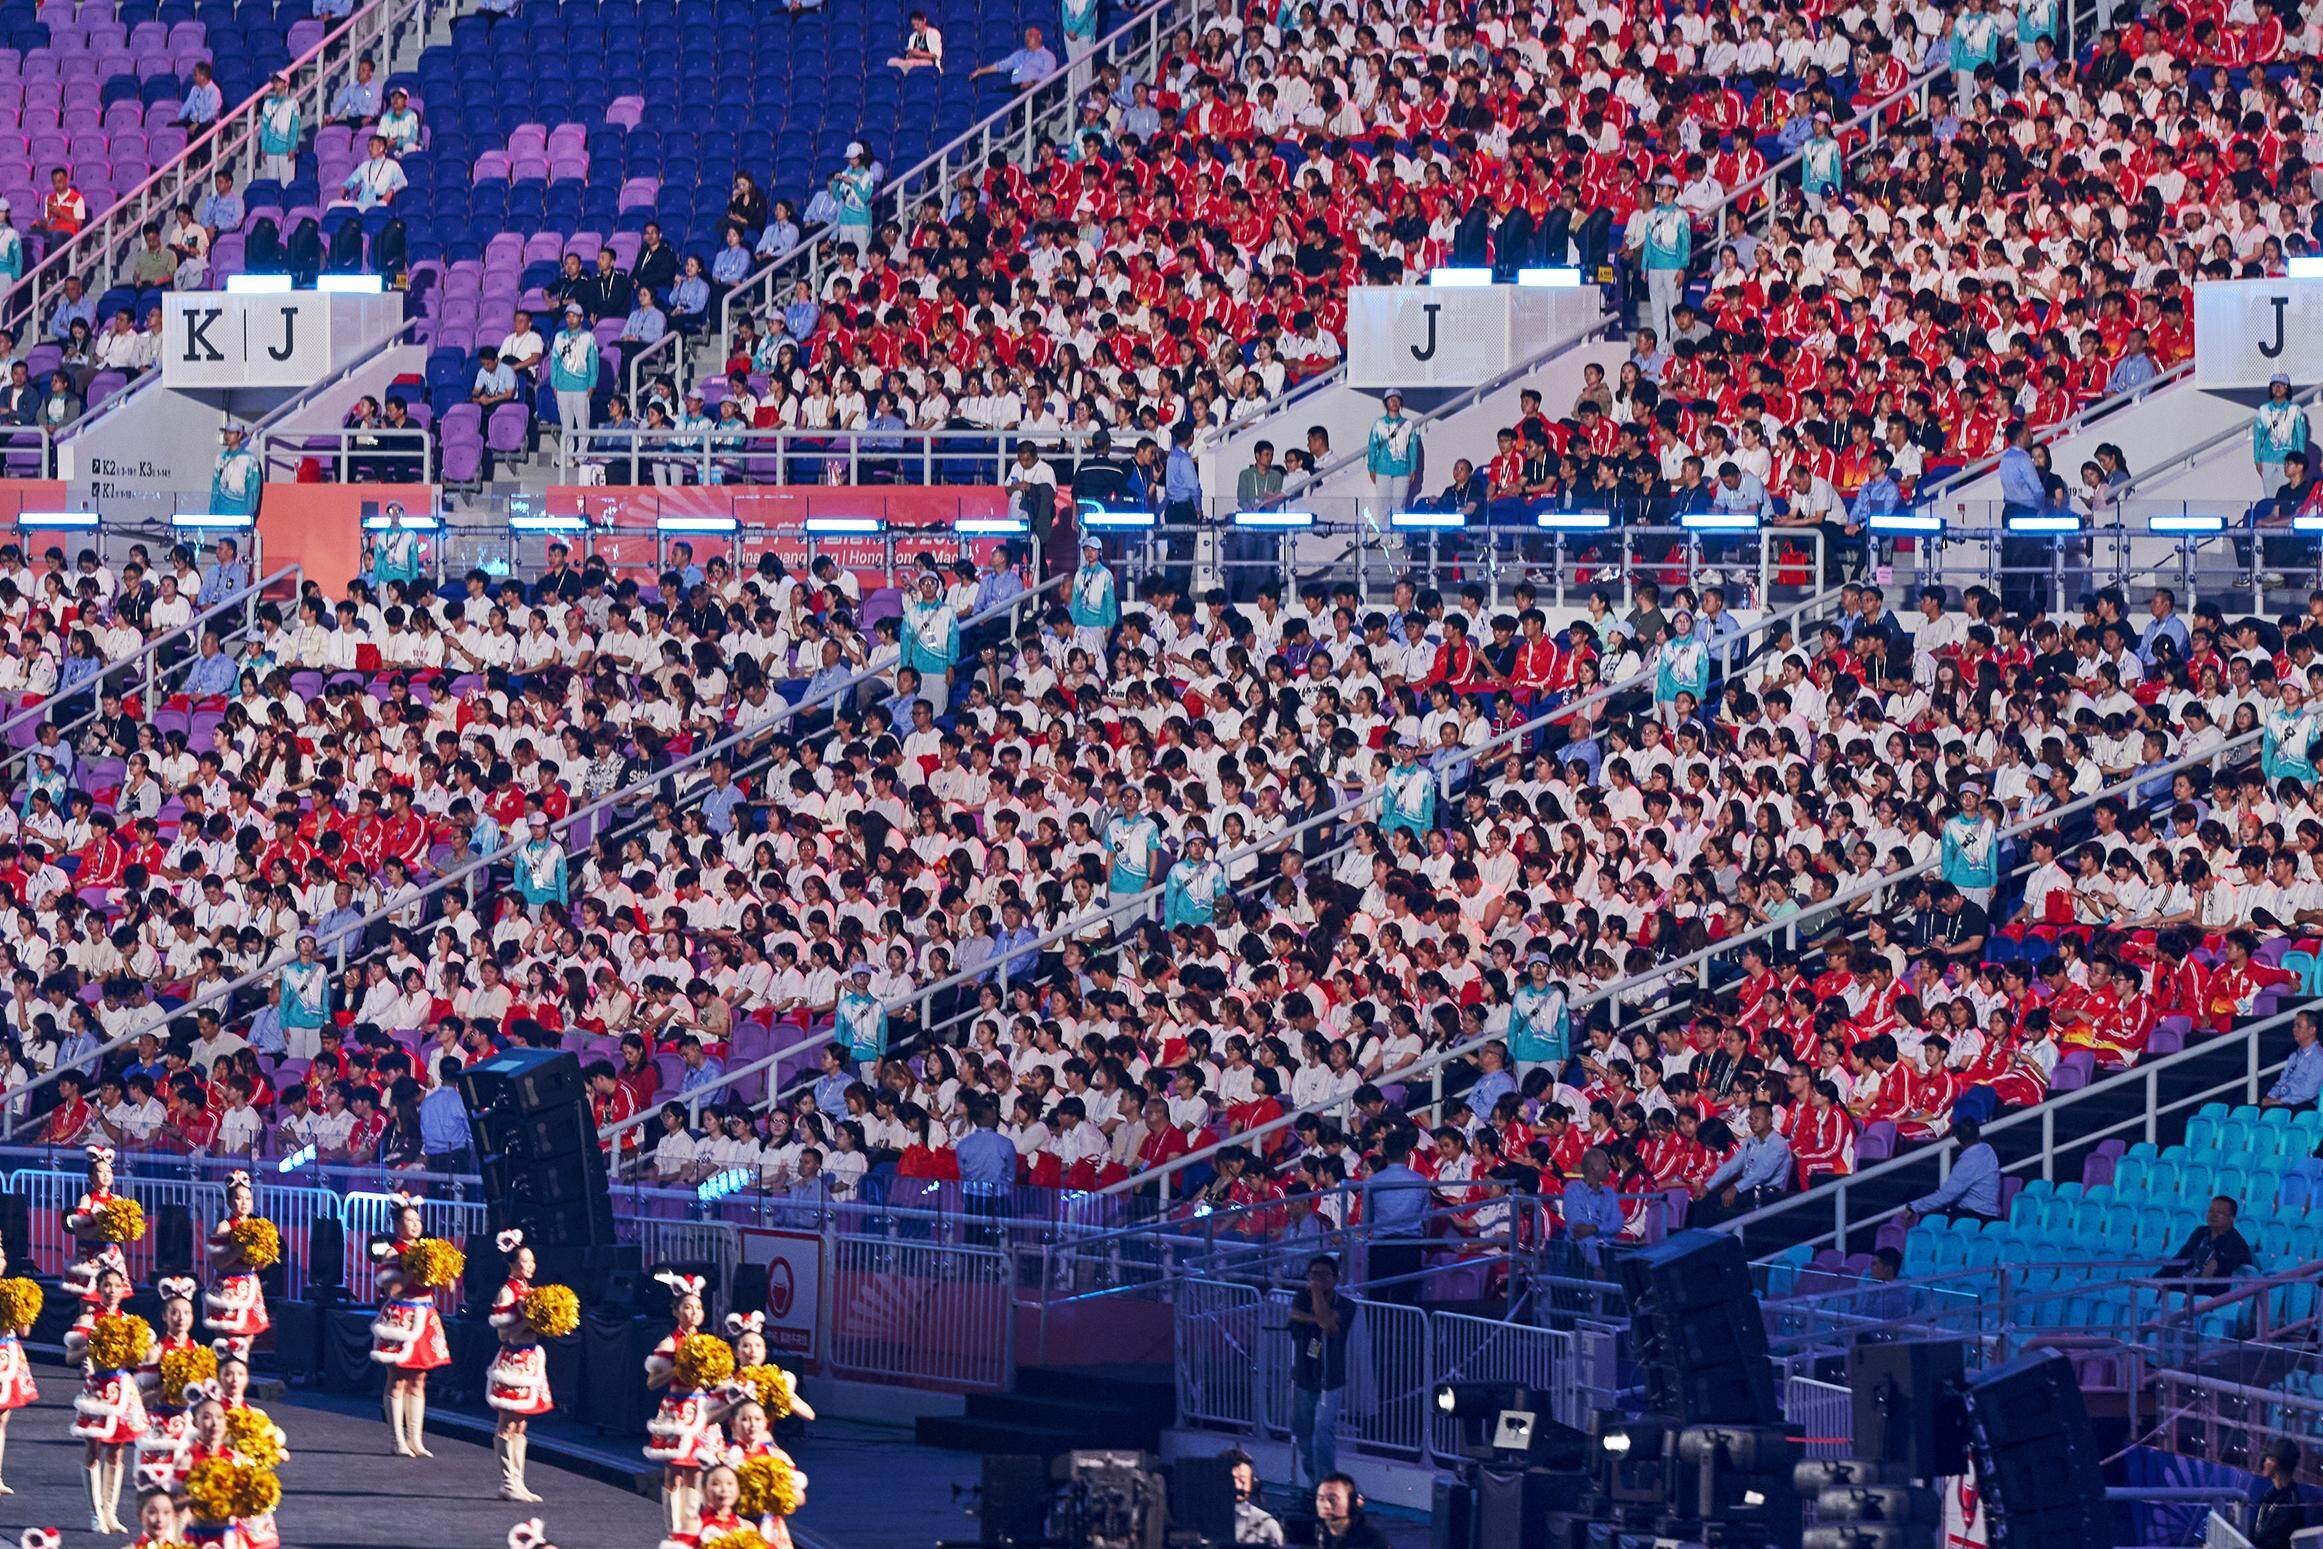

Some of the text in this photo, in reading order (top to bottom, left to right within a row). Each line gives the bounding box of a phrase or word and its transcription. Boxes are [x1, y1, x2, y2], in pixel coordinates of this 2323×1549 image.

[182, 307, 299, 362] K J
[1410, 304, 1441, 361] J
[2258, 297, 2289, 359] J
[103, 460, 116, 476] K2
[139, 461, 152, 477] K3
[103, 483, 114, 498] K1
[725, 548, 761, 564] Cina
